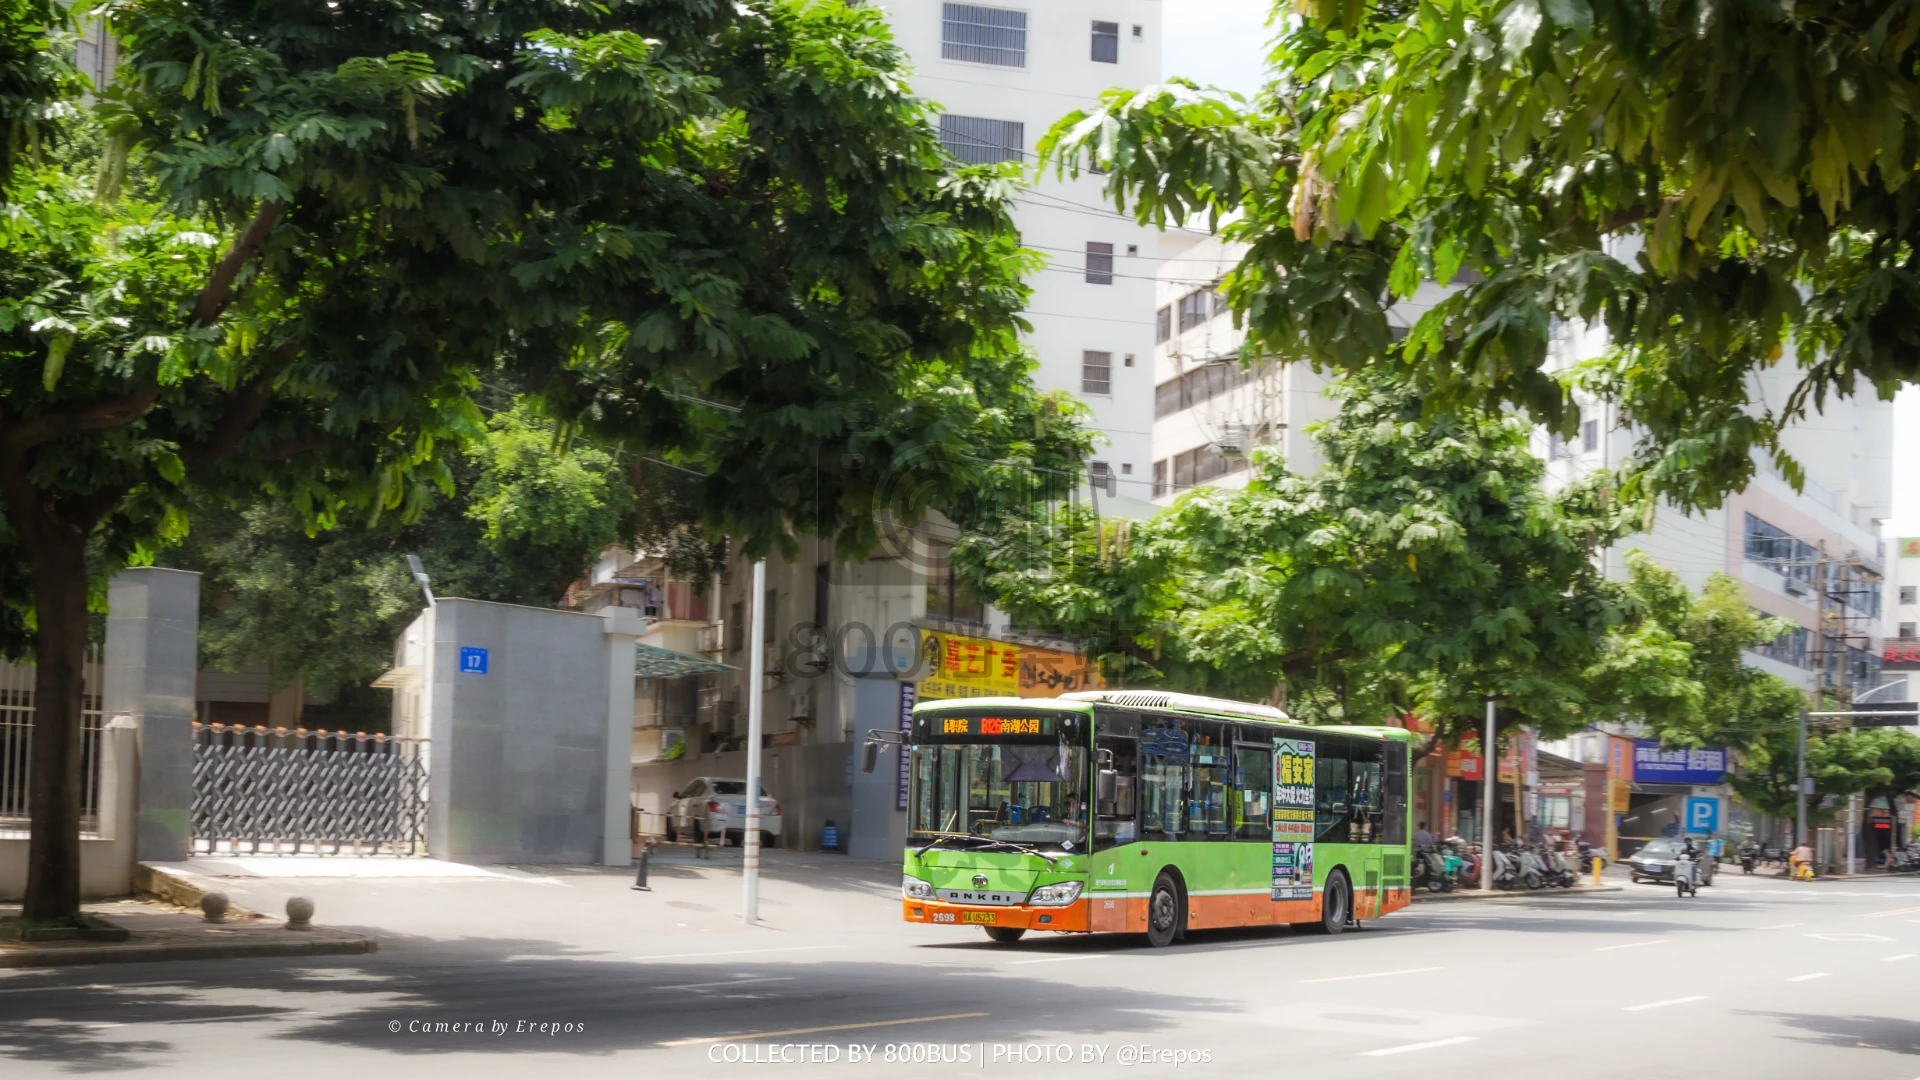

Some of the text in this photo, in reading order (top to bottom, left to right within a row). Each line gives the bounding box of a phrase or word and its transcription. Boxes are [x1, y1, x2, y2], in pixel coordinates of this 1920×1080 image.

[467, 655, 481, 668] 17
[981, 718, 1001, 734] B126
[1001, 718, 1039, 733] 南湖公园
[1281, 753, 1314, 785] 福安家
[950, 892, 1010, 901] ANKAI
[933, 912, 955, 923] 2698
